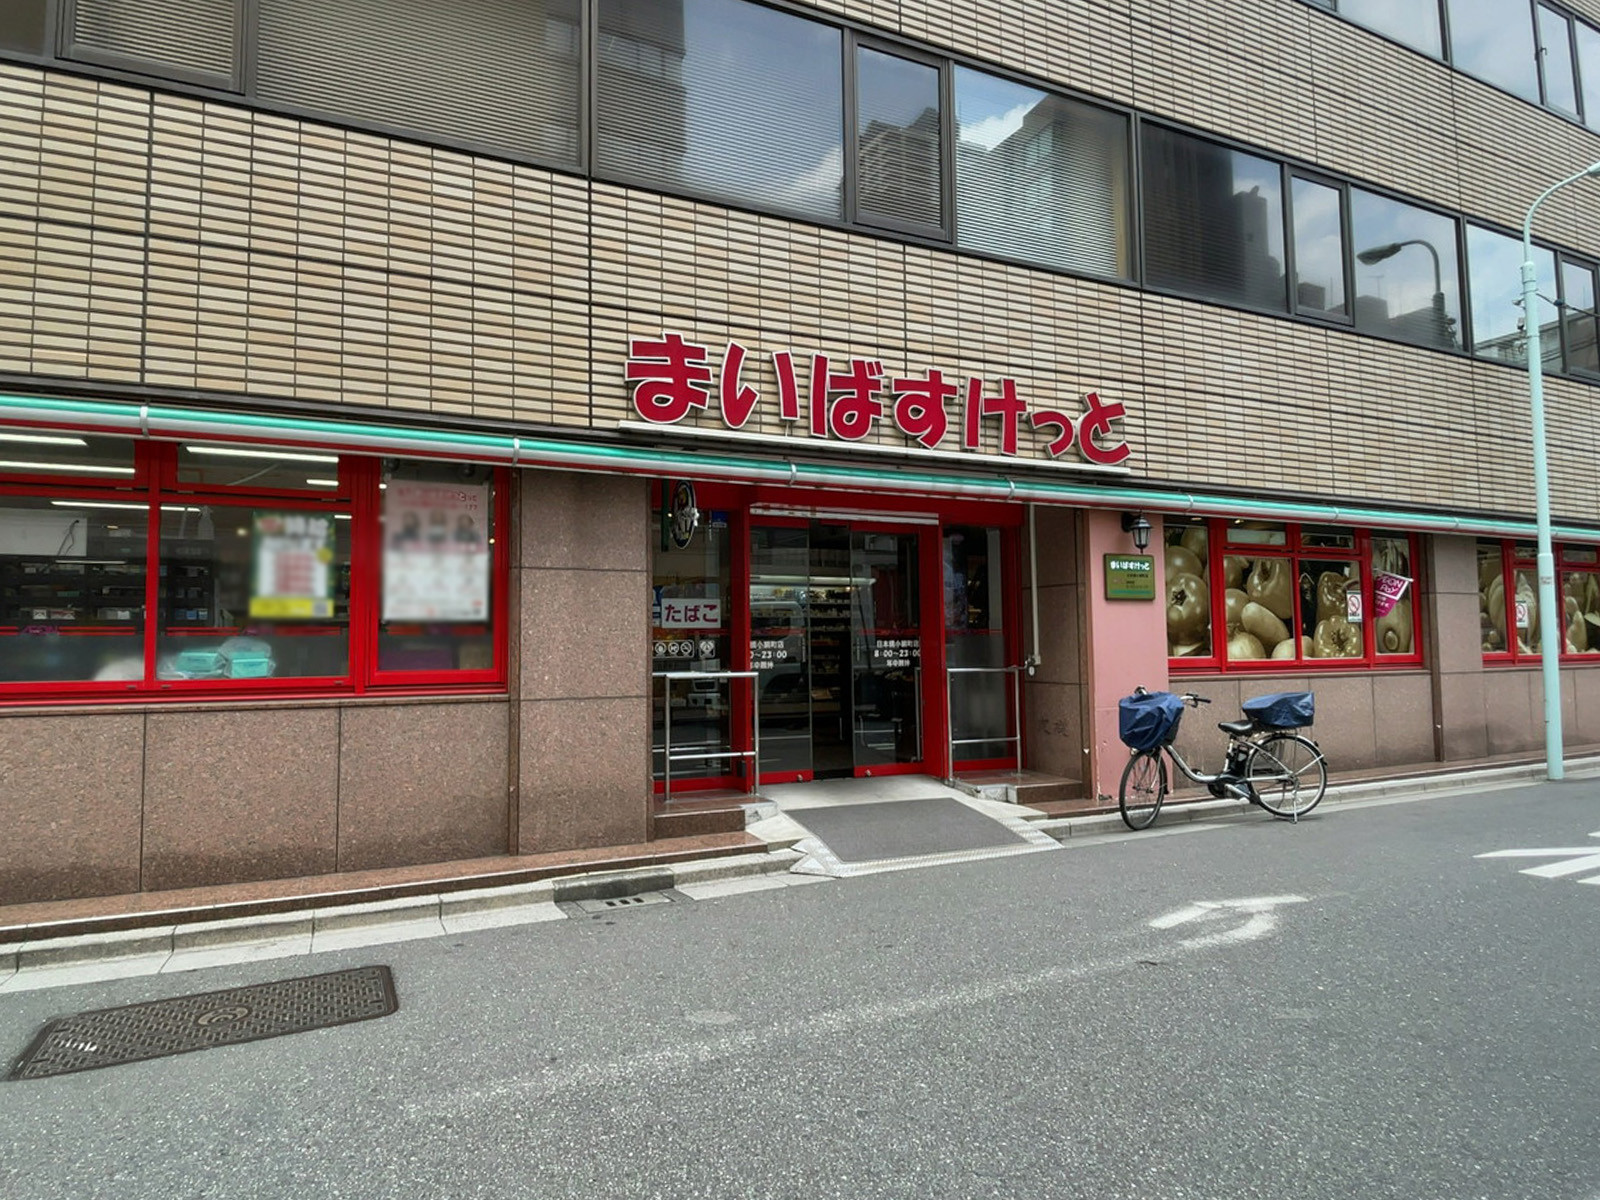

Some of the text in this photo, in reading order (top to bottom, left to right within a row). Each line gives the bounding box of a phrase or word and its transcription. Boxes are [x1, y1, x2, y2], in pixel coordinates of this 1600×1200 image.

[624, 331, 1132, 465] まいばすけっと
[664, 604, 718, 623] たばこ
